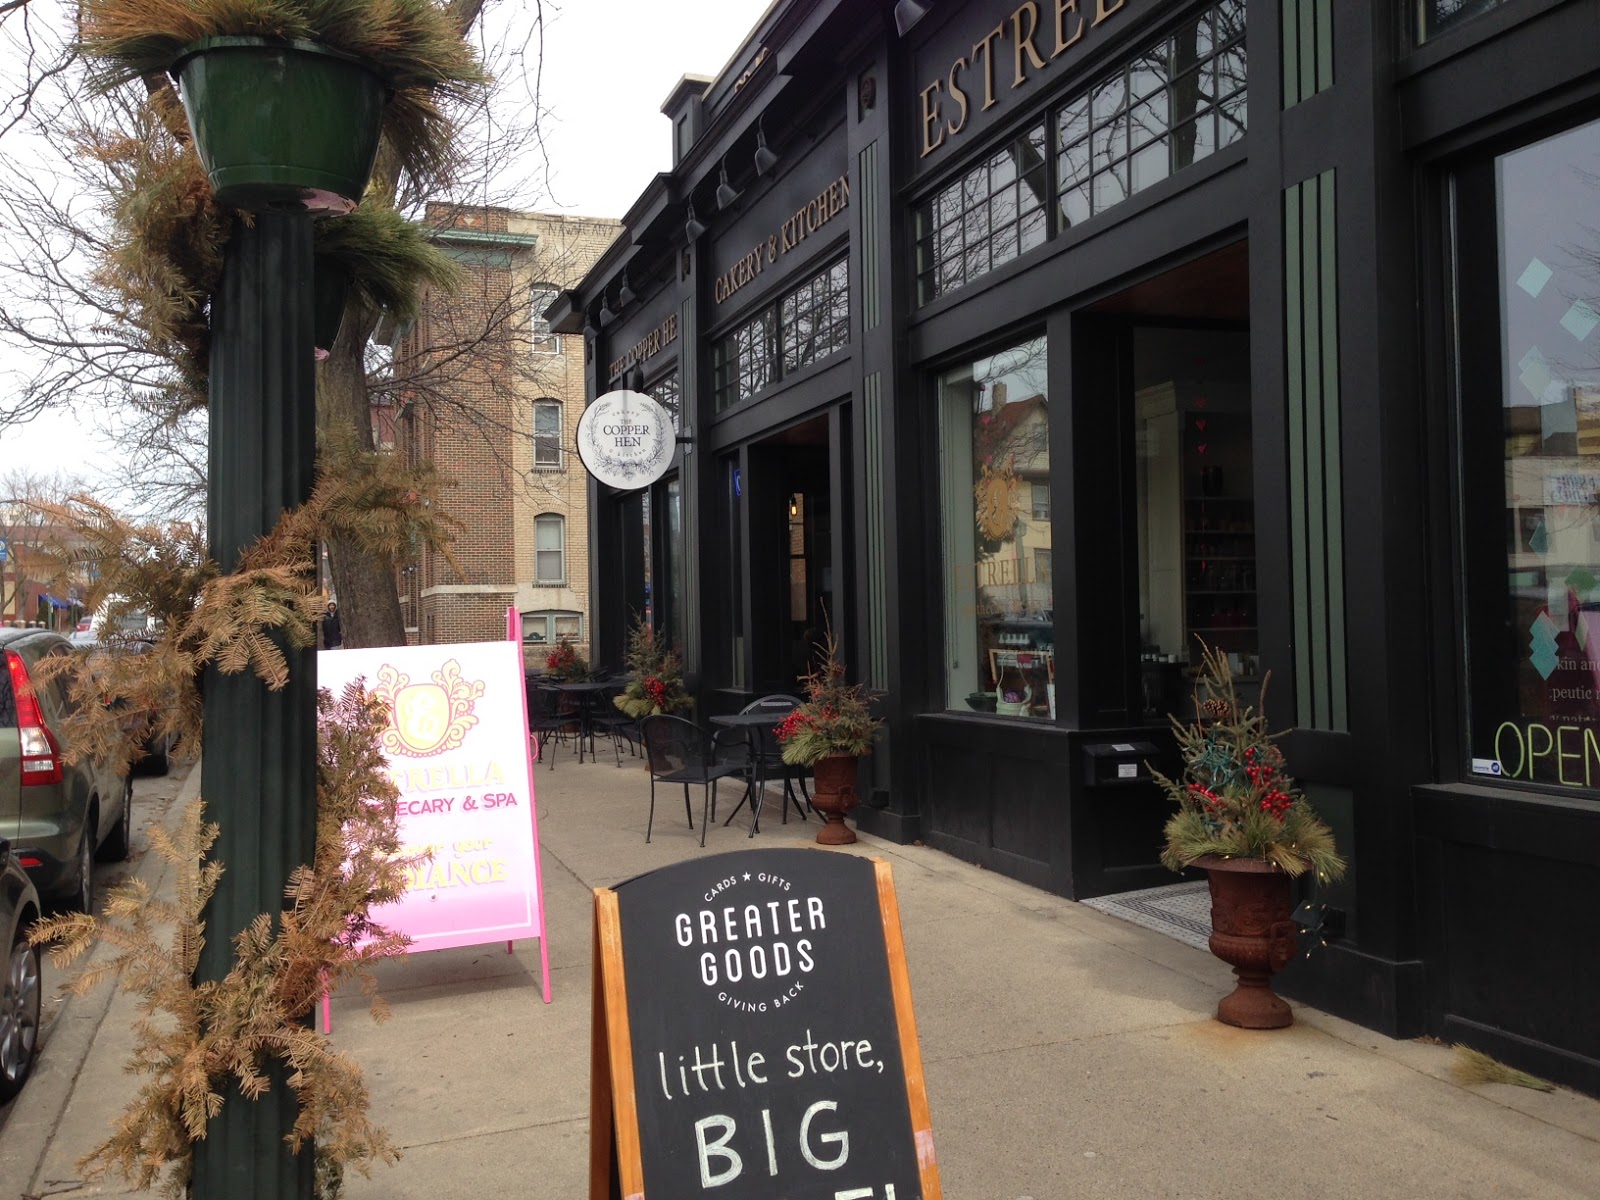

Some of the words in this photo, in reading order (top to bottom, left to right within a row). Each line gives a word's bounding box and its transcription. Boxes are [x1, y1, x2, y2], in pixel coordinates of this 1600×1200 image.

[715, 242, 764, 304] CAKERY
[768, 234, 777, 264] &
[780, 170, 850, 254] KITCHEN
[662, 312, 678, 347] HE
[603, 425, 650, 436] COPPER
[614, 436, 641, 447] HEN
[1549, 684, 1593, 702] peutic
[395, 797, 455, 817] ECARY
[463, 795, 479, 811] &
[483, 792, 518, 809] SPA
[453, 838, 493, 858] your
[401, 858, 509, 891] DIANCE
[704, 876, 737, 902] CARDS
[758, 872, 791, 891] GIFTS
[675, 897, 826, 947] GREATER
[700, 939, 815, 986] GOODS
[718, 992, 767, 1012] GIVING
[773, 981, 804, 1008] BACK
[659, 1041, 769, 1100] little
[786, 1029, 884, 1078] store,
[694, 1100, 850, 1189] BIG
